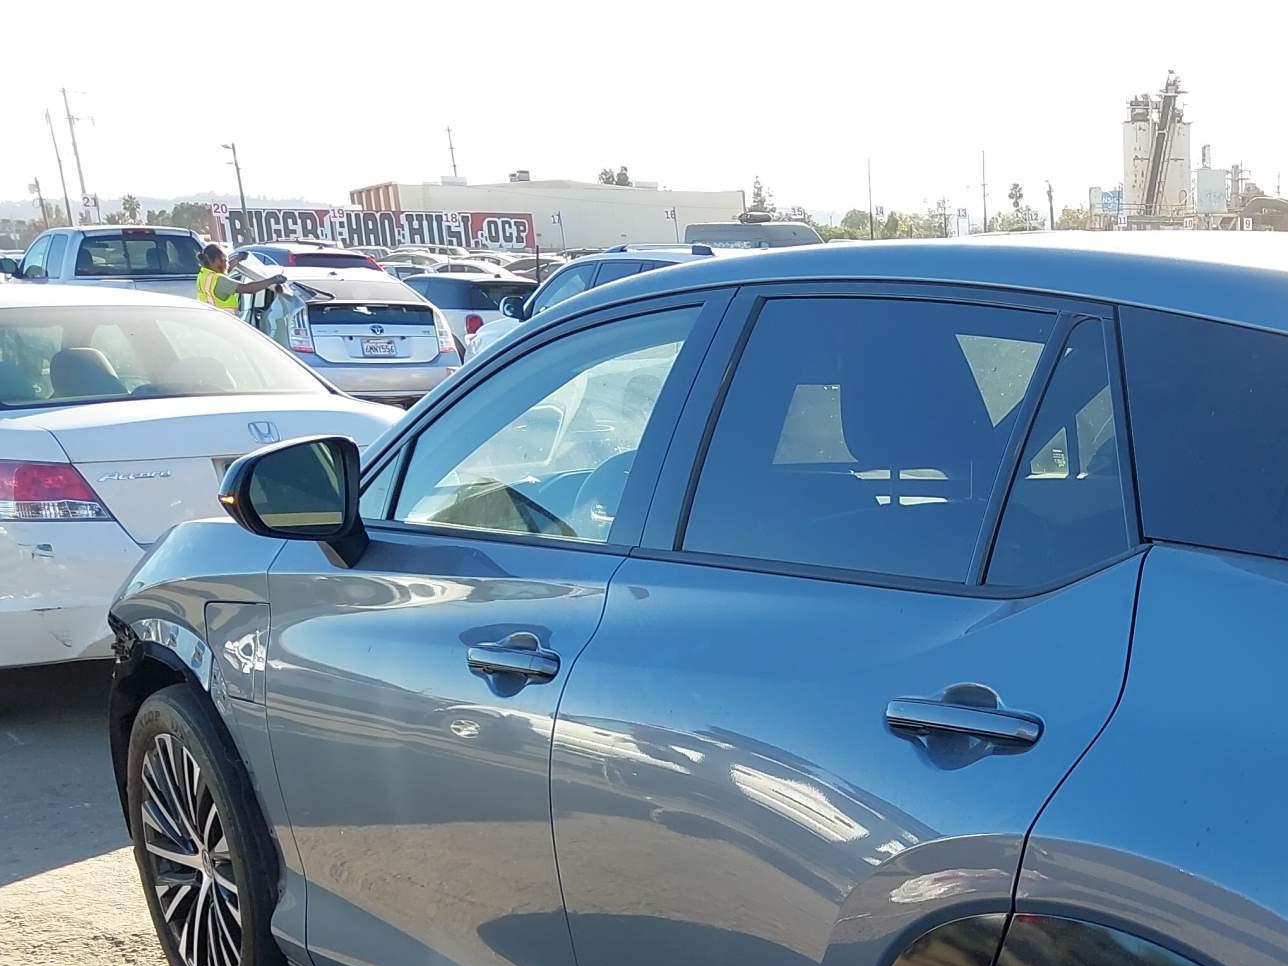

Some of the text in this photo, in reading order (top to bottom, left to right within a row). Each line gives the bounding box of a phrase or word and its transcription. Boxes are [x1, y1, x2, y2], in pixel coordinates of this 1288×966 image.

[82, 196, 97, 207] 21
[213, 203, 228, 214] 20
[331, 208, 344, 219] 19
[791, 207, 803, 216] 15
[957, 208, 967, 217] 13
[445, 213, 458, 223] 18
[1119, 216, 1127, 225] 11
[1184, 219, 1194, 228] 10
[486, 219, 528, 245] OCP
